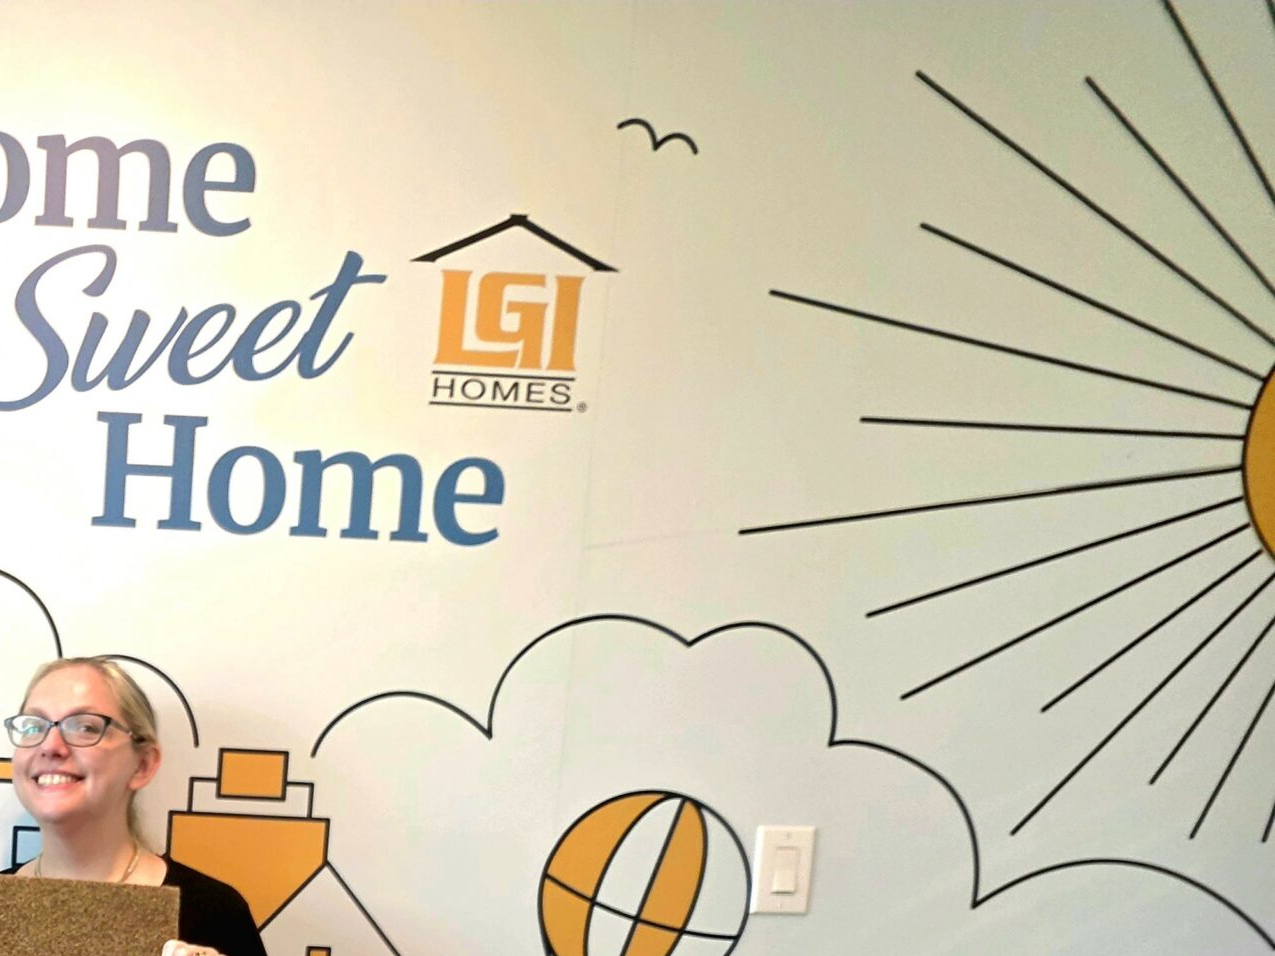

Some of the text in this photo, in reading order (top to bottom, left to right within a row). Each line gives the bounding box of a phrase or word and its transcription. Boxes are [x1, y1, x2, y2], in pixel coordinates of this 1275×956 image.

[433, 268, 586, 372] LGI
[432, 377, 572, 405] HOMES
[91, 410, 506, 547] Home
